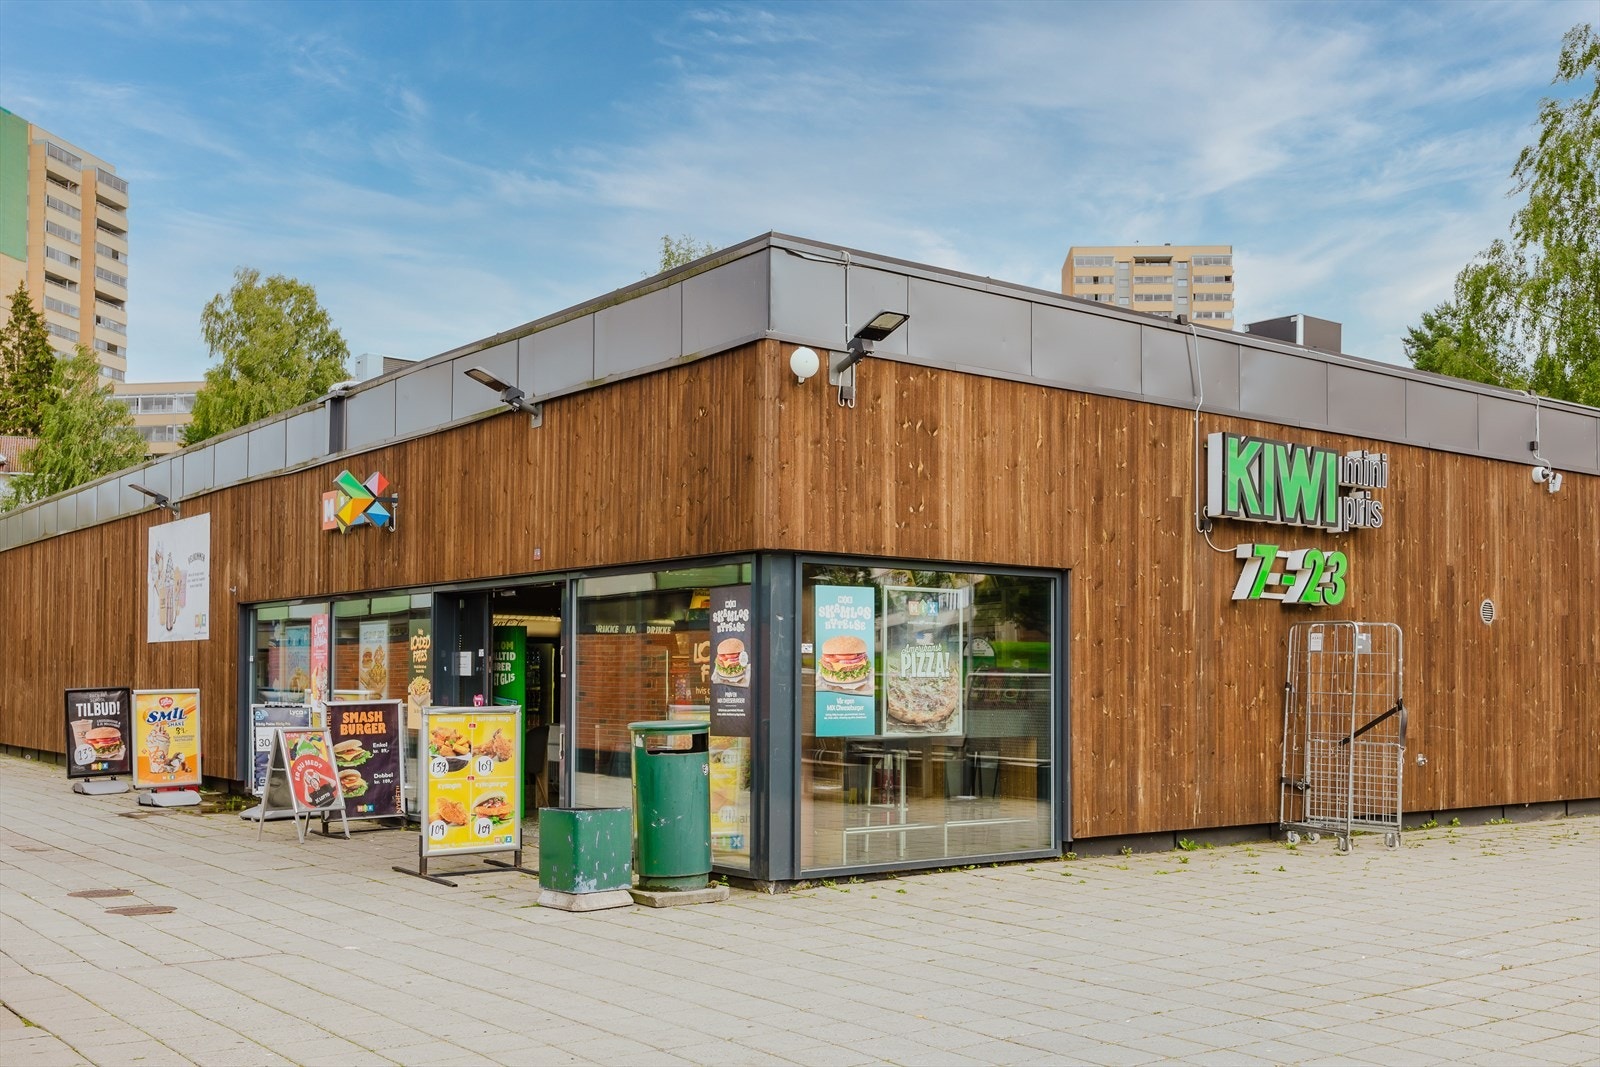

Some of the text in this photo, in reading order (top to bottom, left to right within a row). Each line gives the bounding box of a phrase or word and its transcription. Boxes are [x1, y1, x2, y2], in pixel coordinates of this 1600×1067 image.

[1343, 449, 1388, 489] mini
[1225, 432, 1339, 528] KIWI
[1343, 491, 1383, 533] pris
[646, 625, 672, 635] DRIKKE
[901, 652, 950, 678] PIZZA!
[500, 673, 516, 686] GLIS
[75, 701, 121, 717] TILBUD!
[147, 707, 187, 723] SMIL
[342, 711, 383, 723] SMASH
[340, 722, 387, 736] BURGER
[297, 762, 305, 772] DU
[304, 759, 323, 768] MED?
[430, 824, 445, 837] 109
[477, 822, 491, 835] 109
